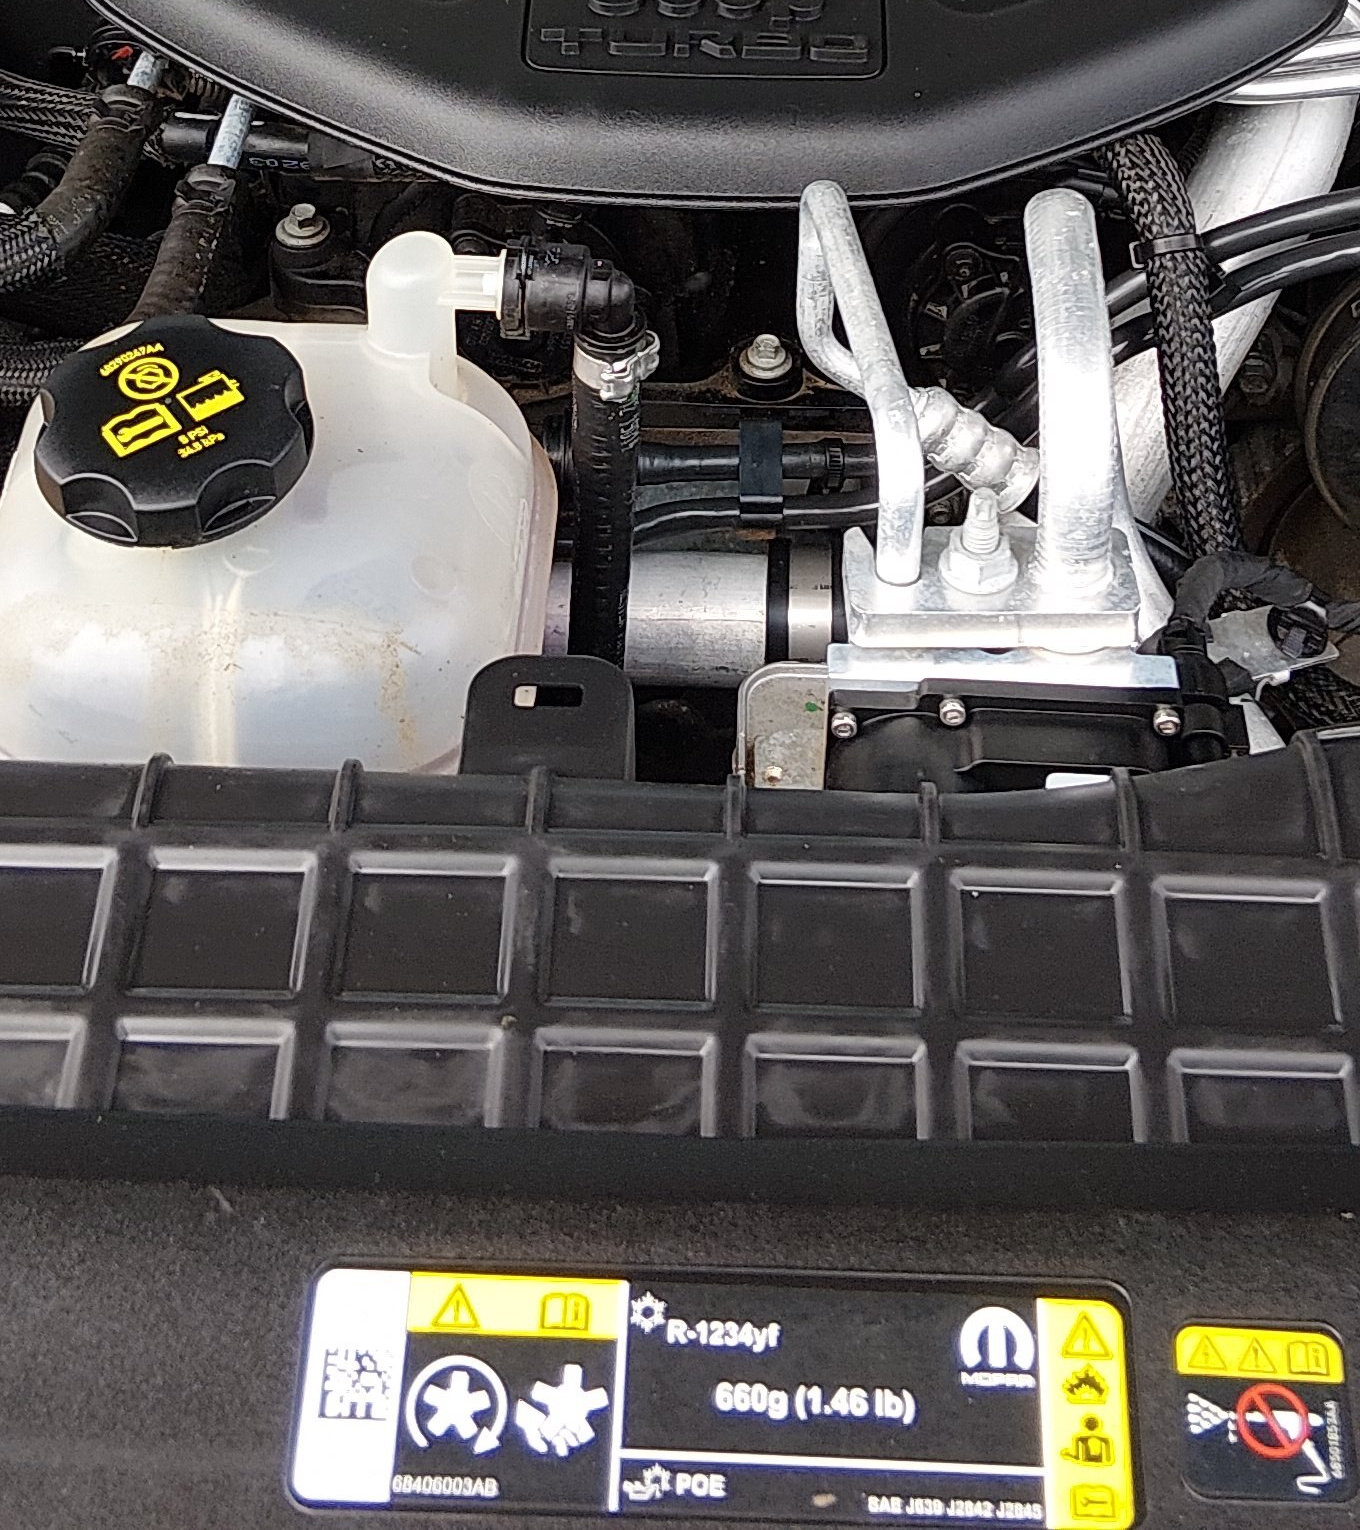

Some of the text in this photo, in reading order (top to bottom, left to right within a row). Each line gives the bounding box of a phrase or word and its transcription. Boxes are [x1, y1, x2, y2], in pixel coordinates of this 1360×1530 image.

[541, 26, 869, 63] TURBO
[188, 425, 209, 438] PSI
[666, 1319, 782, 1353] R-1234yf
[960, 1371, 1037, 1389] MOPAR
[715, 1381, 916, 1425] 660g (1.46 lb)
[675, 1472, 727, 1498] POE
[867, 1494, 903, 1515] SAE
